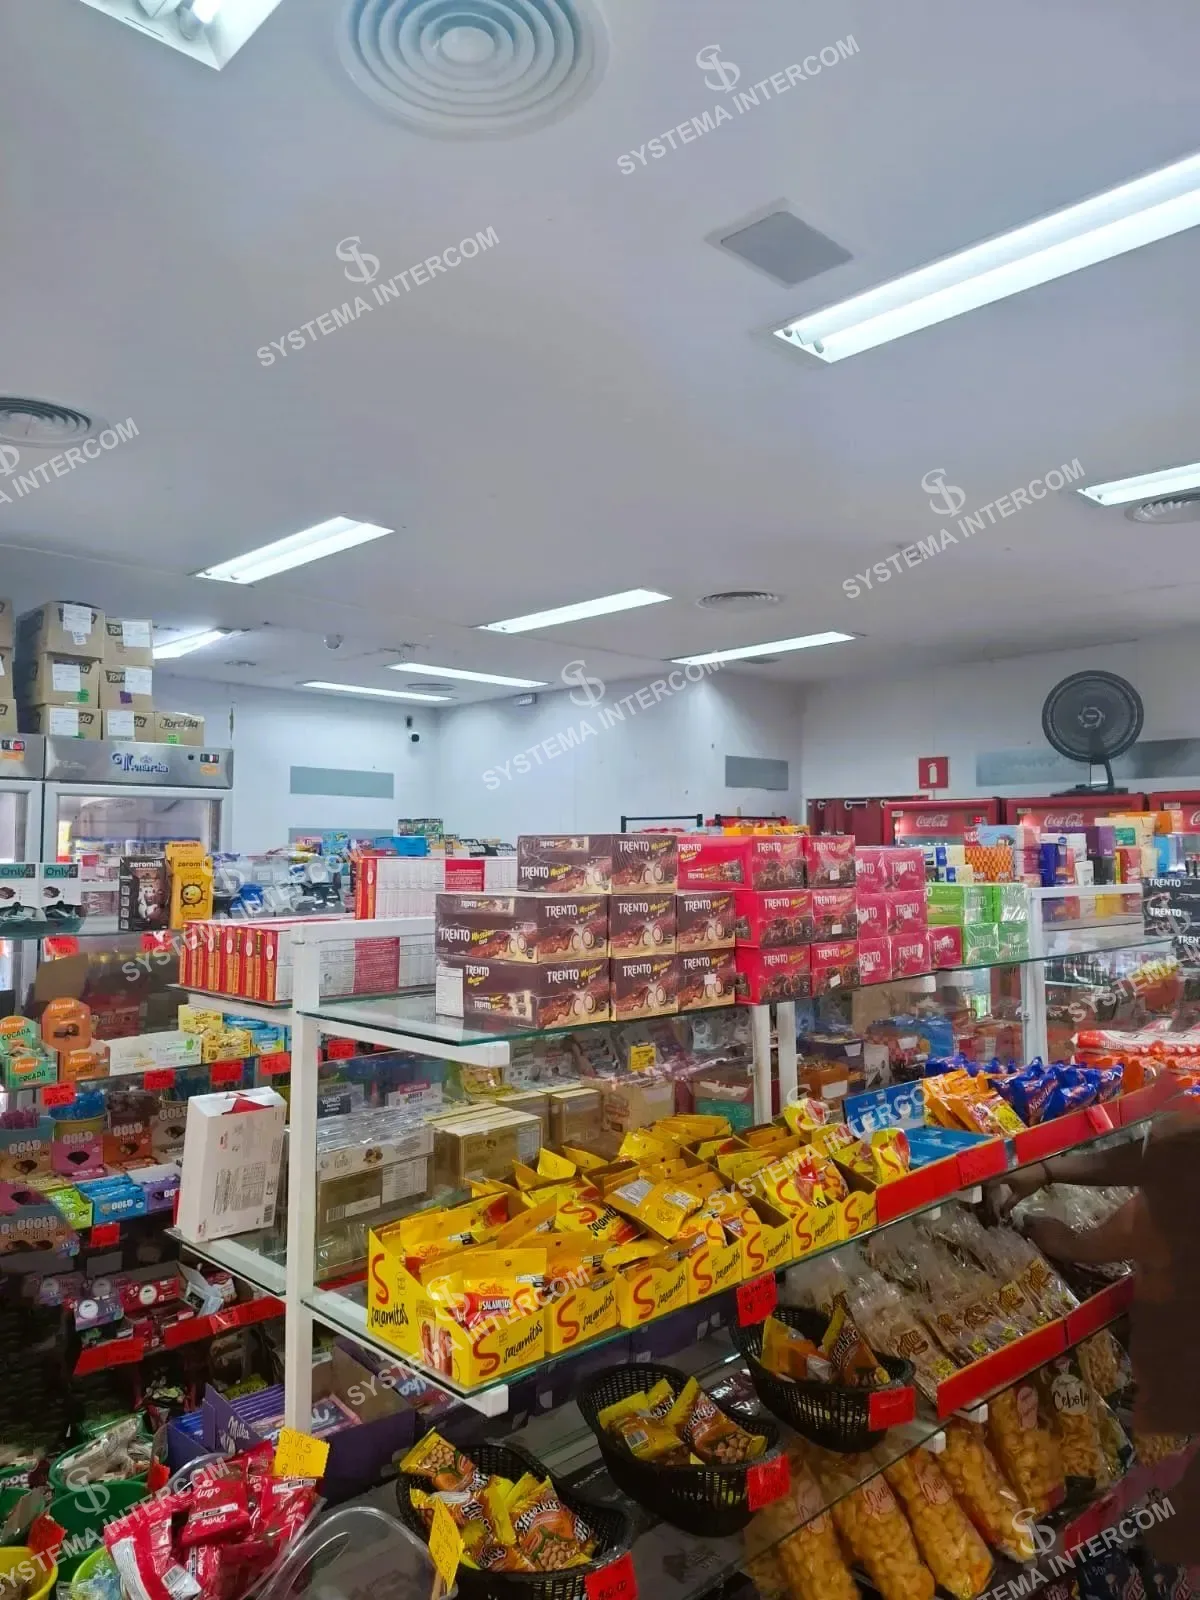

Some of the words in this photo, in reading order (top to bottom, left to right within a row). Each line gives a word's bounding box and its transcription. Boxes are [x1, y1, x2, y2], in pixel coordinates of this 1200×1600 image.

[619, 841, 649, 854] TRENTO
[678, 843, 702, 852] TRENTO
[757, 842, 782, 852] TRENTO
[130, 860, 162, 868] zeromilk
[521, 866, 548, 880] TRENTO
[1149, 878, 1181, 888] TRENTO
[684, 900, 712, 912] TRENTO
[764, 898, 790, 909] TRENTO
[814, 896, 836, 906] TRENTO
[545, 905, 578, 918] TRENTO
[618, 903, 648, 916] TRENTO
[1150, 908, 1182, 918] TRENTO
[440, 928, 470, 943] TRENTO
[764, 954, 788, 966] TRENTO
[817, 948, 840, 960] TRENTO
[683, 957, 710, 970] TRENTO
[466, 965, 490, 978] TRENTO
[547, 970, 579, 984] TRENTO
[623, 964, 652, 978] TRENTO
[2, 1028, 31, 1042] COCADA
[18, 1070, 46, 1082] COCADA
[228, 1416, 250, 1440] Milka
